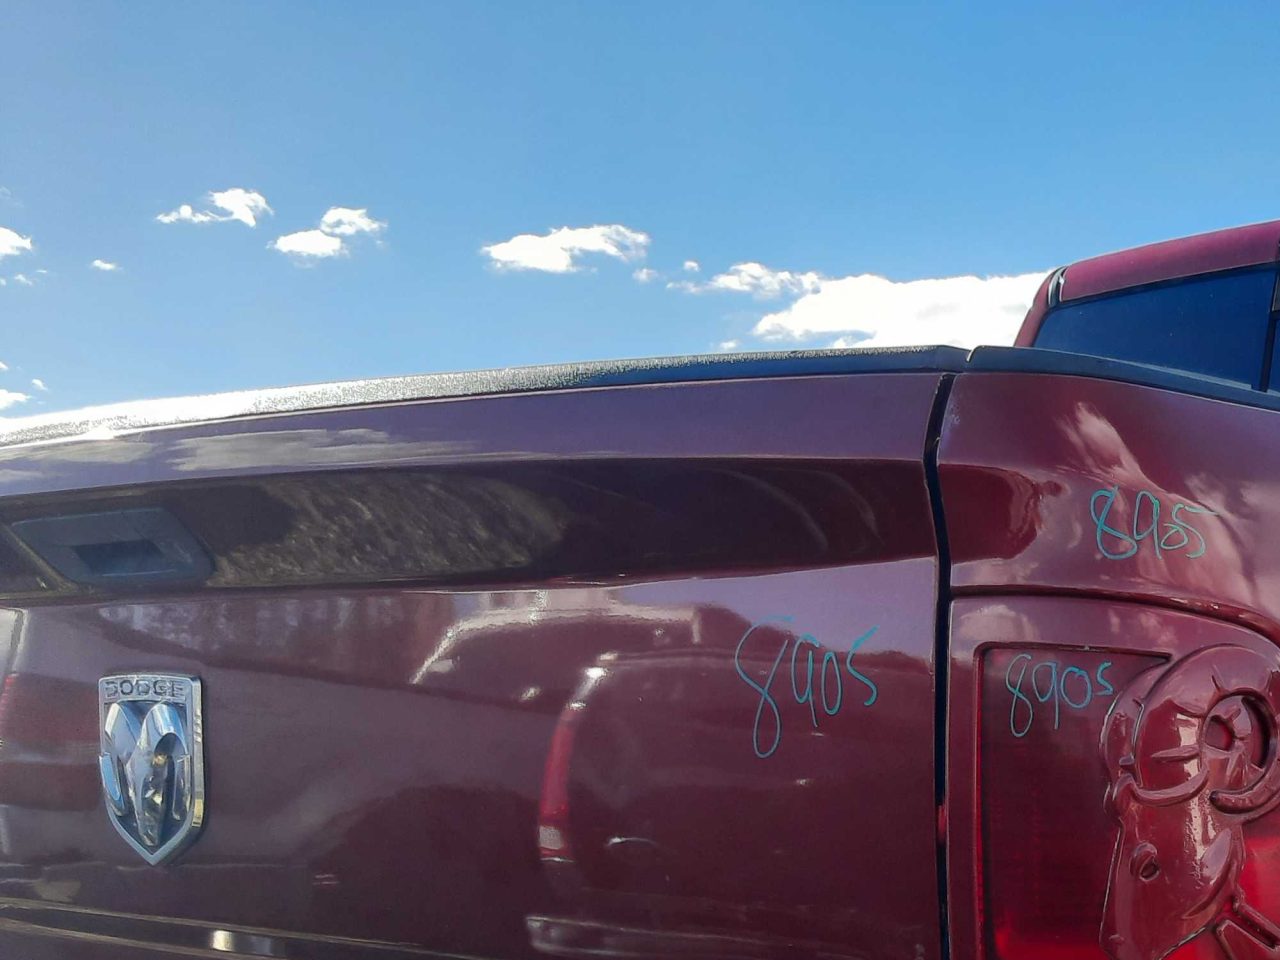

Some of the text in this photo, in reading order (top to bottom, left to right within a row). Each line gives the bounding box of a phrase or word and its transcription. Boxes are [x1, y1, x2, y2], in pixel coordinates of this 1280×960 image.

[1090, 484, 1220, 560] 8905
[104, 679, 186, 698] DODGE
[734, 615, 880, 759] 8905
[1006, 653, 1113, 738] 8905
